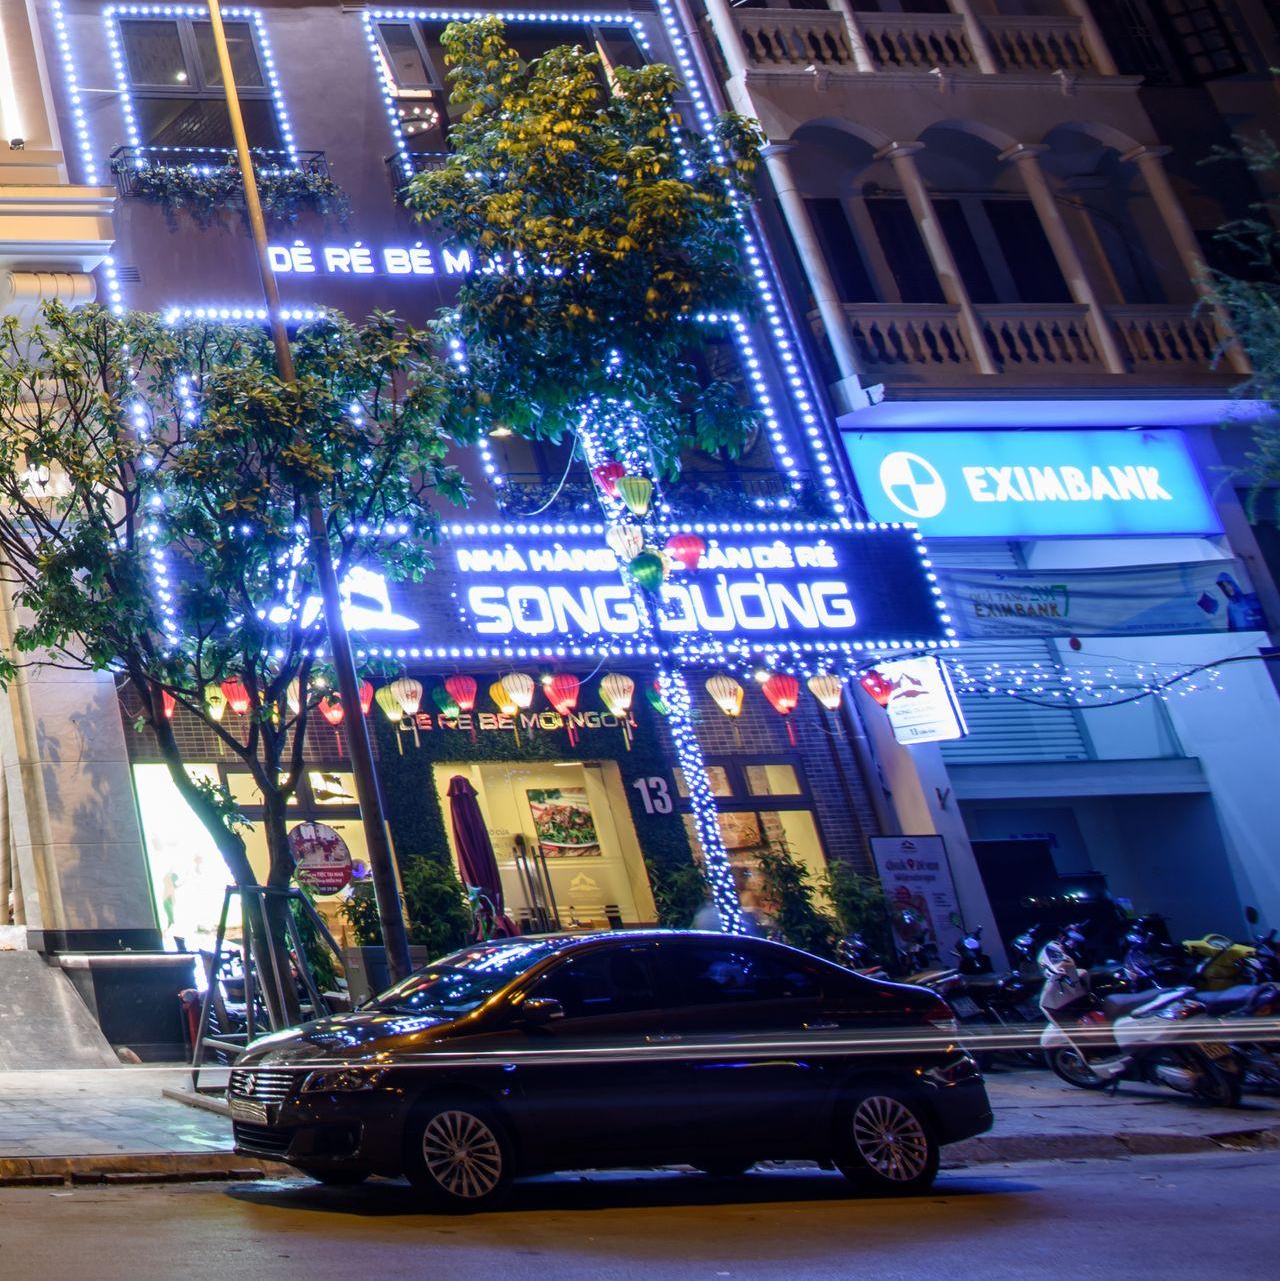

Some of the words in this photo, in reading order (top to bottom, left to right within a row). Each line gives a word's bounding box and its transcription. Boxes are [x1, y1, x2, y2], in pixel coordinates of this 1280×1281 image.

[268, 239, 315, 273] DÊ
[324, 241, 374, 274] RÉ
[384, 241, 434, 274] BÉ
[961, 464, 1172, 503] EXIMBANK
[457, 543, 528, 572] NHÀ
[469, 585, 639, 634] SONG
[659, 573, 857, 633] DƯƠNG
[974, 602, 1062, 618] EXIMBANK
[633, 776, 673, 815] 13
